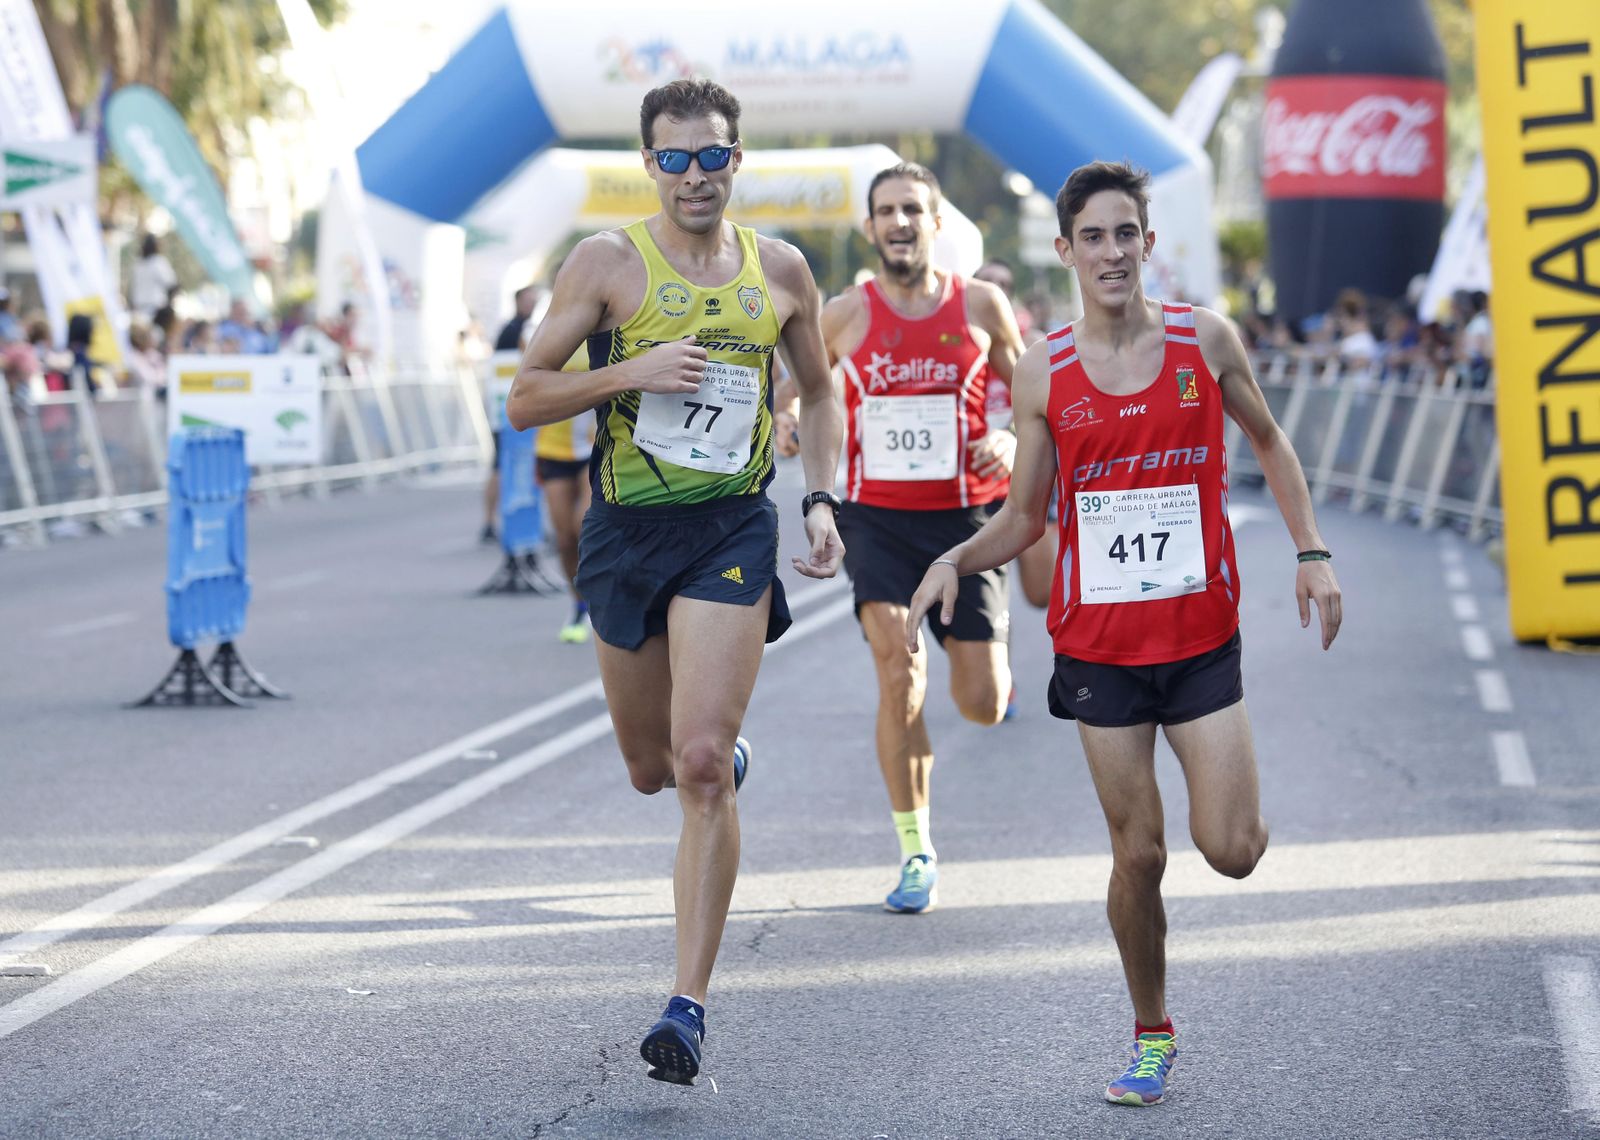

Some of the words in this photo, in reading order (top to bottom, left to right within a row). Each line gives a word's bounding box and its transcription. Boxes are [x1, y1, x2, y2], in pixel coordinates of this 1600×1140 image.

[1515, 20, 1600, 545] RENAULT
[729, 369, 755, 378] URBAA
[885, 357, 958, 383] califas
[724, 397, 752, 405] FEDERADO
[684, 401, 723, 433] 77
[646, 440, 672, 450] RENAULT
[886, 430, 932, 451] 303
[1115, 493, 1155, 502] CARRERA
[1157, 489, 1193, 499] URBANA
[1112, 503, 1145, 512] CIUDAD
[1147, 503, 1158, 511] DE
[1157, 519, 1193, 527] FEDERADO
[1108, 531, 1171, 564] 417
